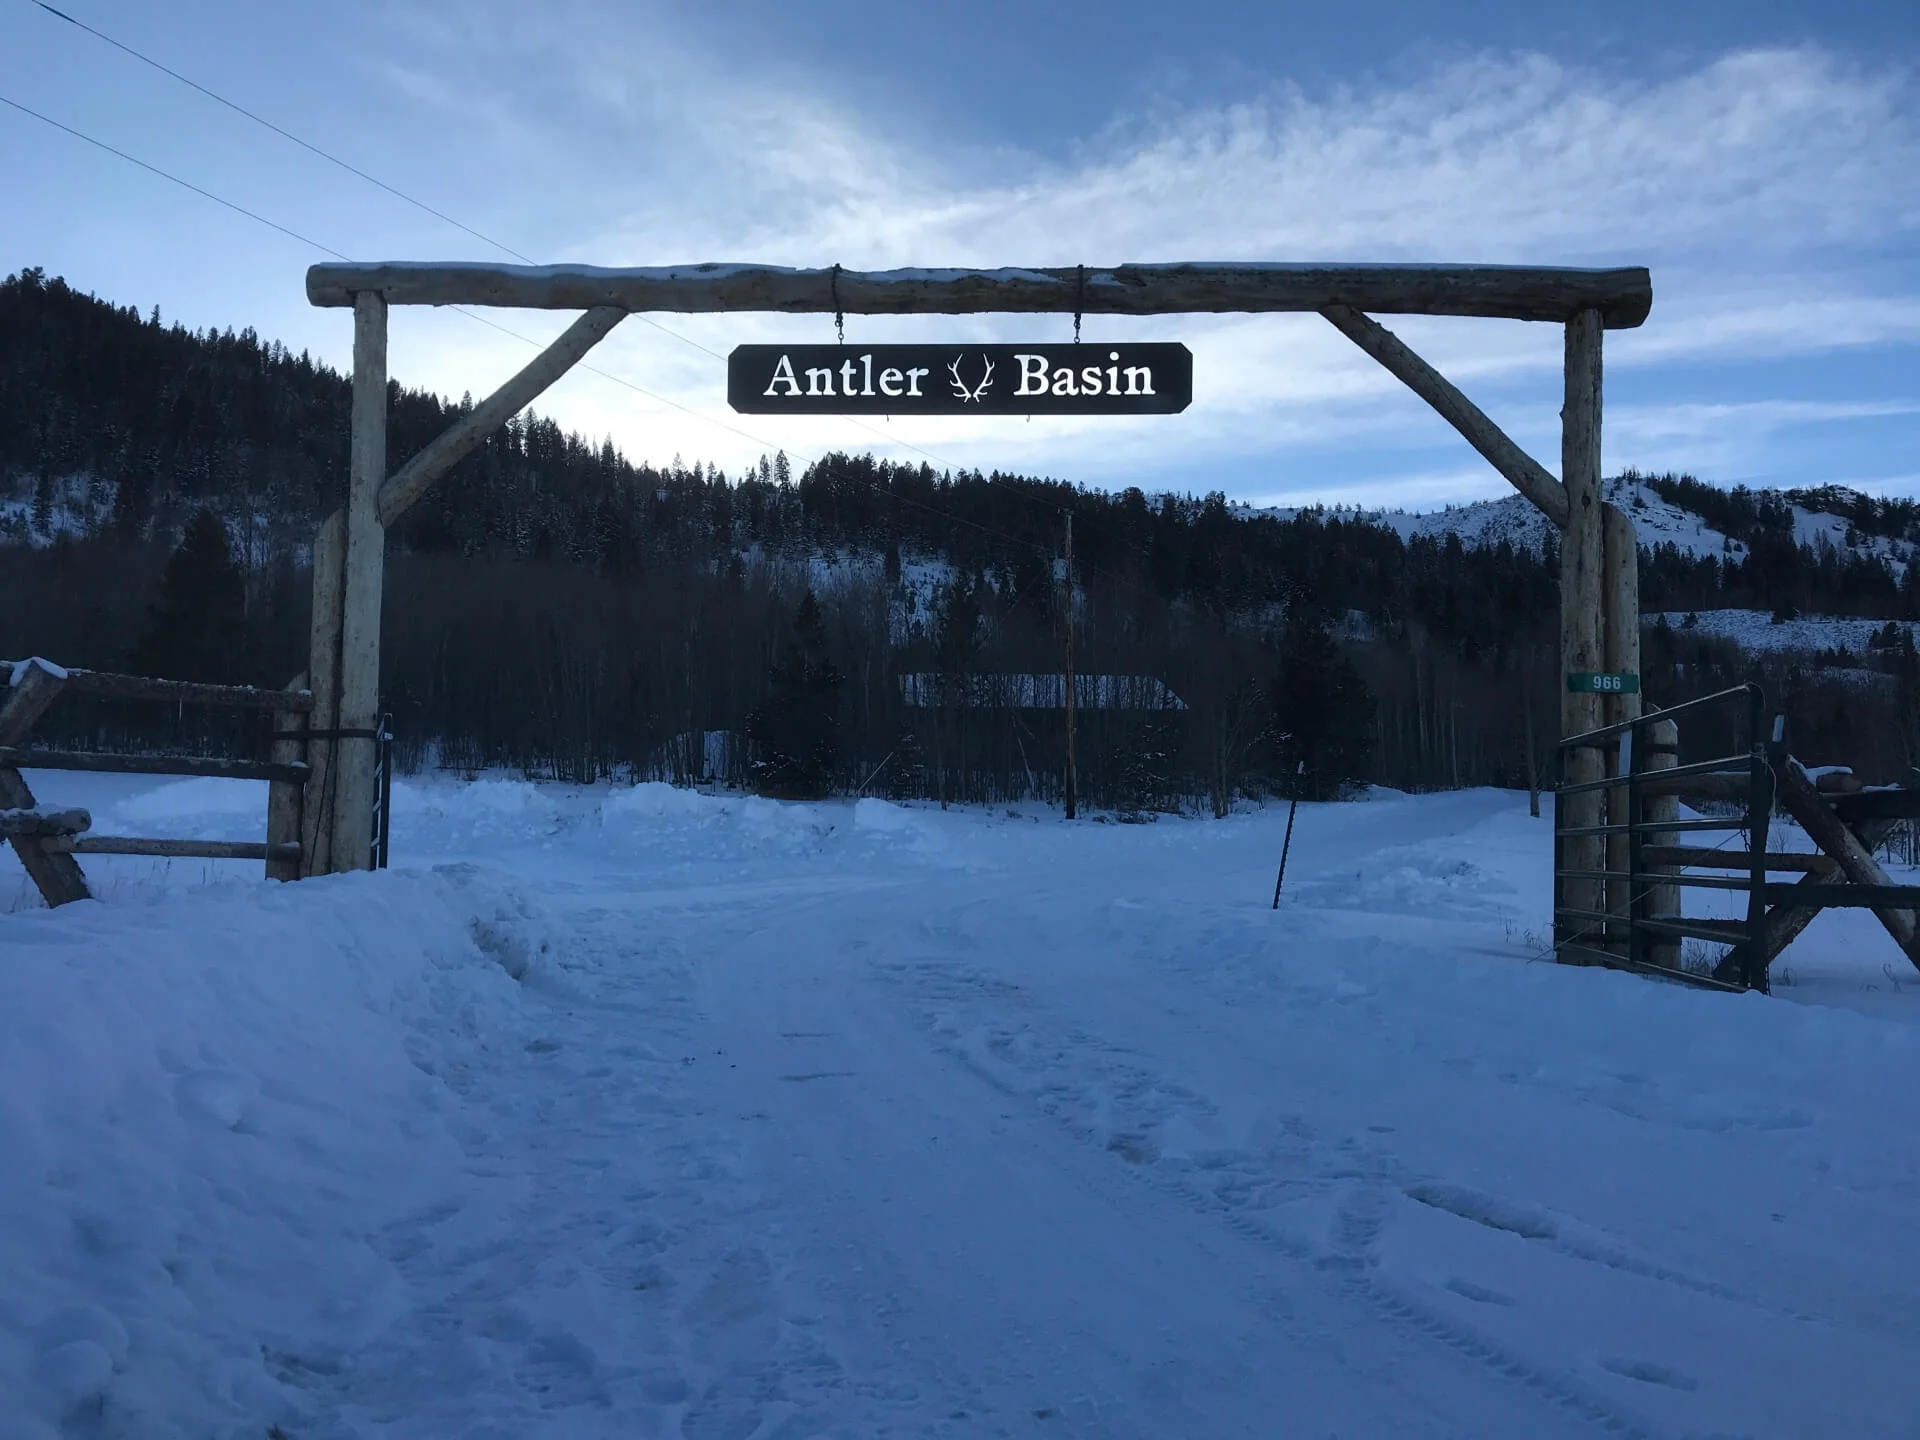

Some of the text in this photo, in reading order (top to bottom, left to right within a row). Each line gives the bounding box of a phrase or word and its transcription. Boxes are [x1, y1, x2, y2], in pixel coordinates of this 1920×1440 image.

[762, 351, 1157, 397] Antler Basin
[1593, 676, 1621, 690] 966
